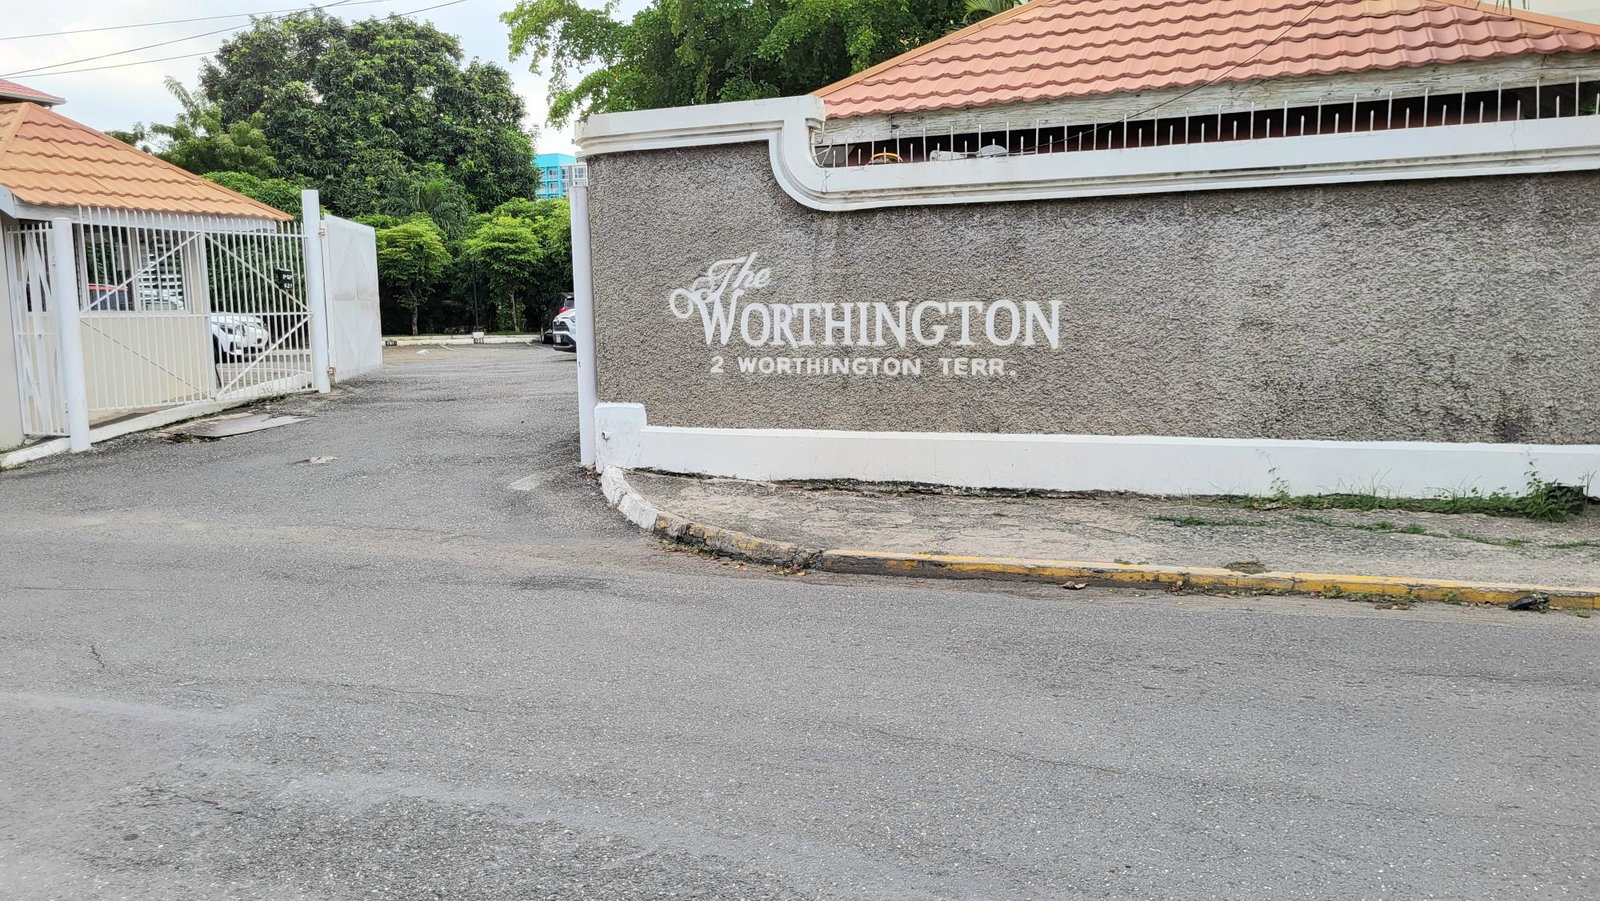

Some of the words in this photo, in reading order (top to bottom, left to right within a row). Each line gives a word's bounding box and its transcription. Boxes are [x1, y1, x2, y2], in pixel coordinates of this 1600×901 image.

[690, 252, 772, 298] The
[669, 288, 1063, 348] WORTHINGTON
[710, 356, 724, 374] 2
[738, 356, 921, 376] WORTHINGTON
[939, 357, 1017, 376] TERR.
